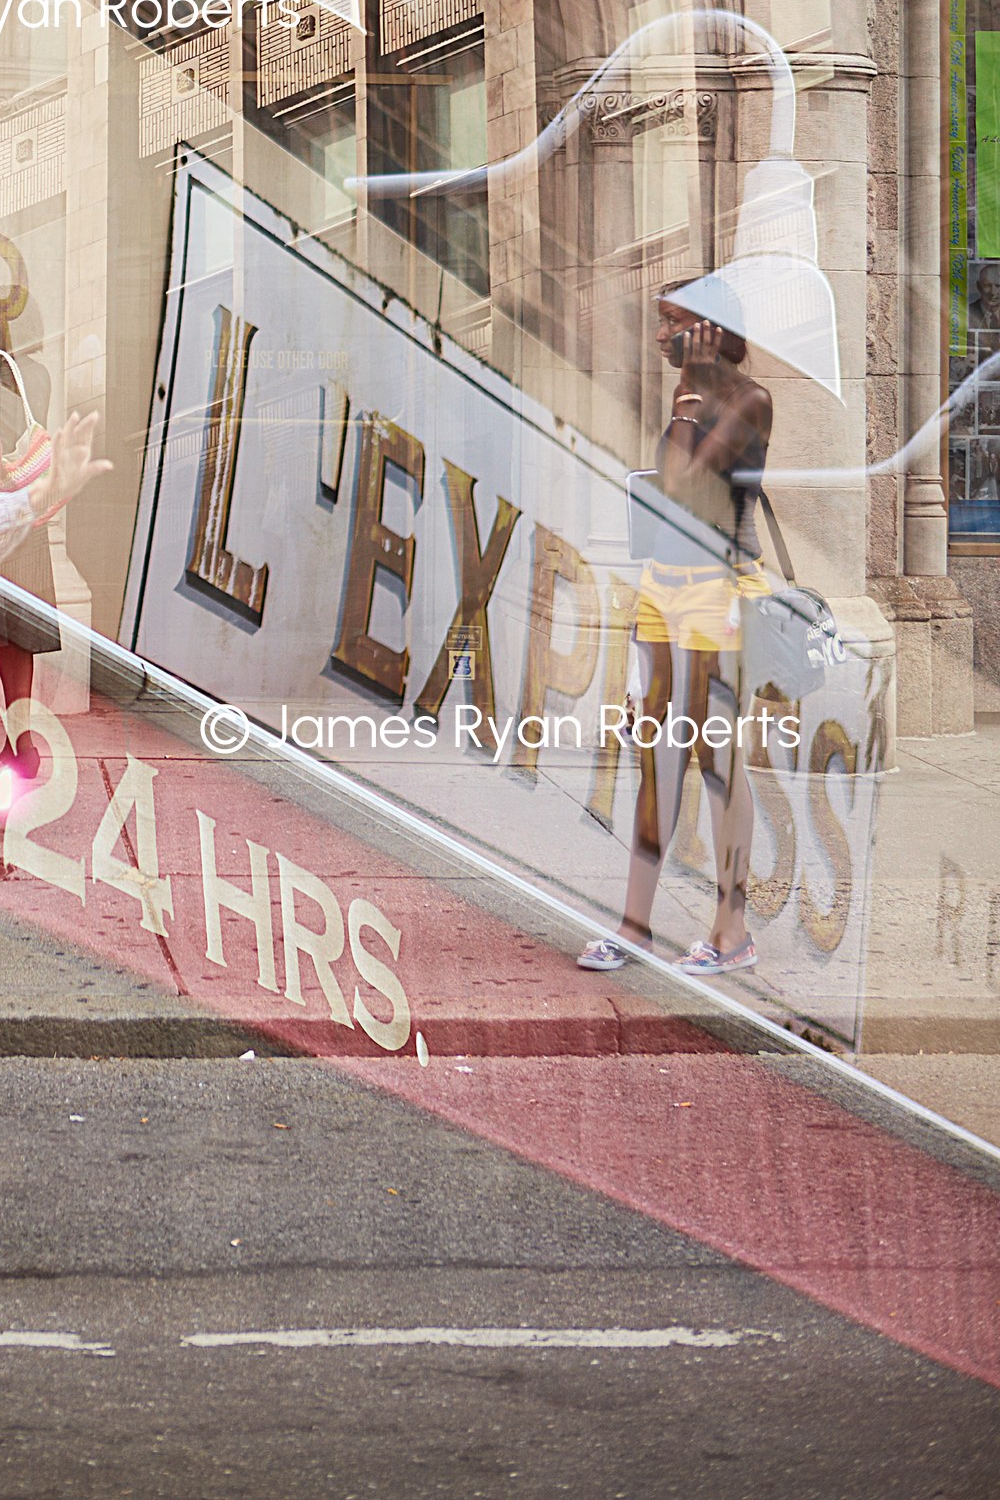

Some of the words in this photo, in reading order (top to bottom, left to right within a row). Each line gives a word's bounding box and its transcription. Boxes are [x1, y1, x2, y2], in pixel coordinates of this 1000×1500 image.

[252, 351, 275, 369] USE
[277, 351, 314, 370] OTHER
[318, 351, 350, 370] DOOR
[1, 698, 175, 940] 24
